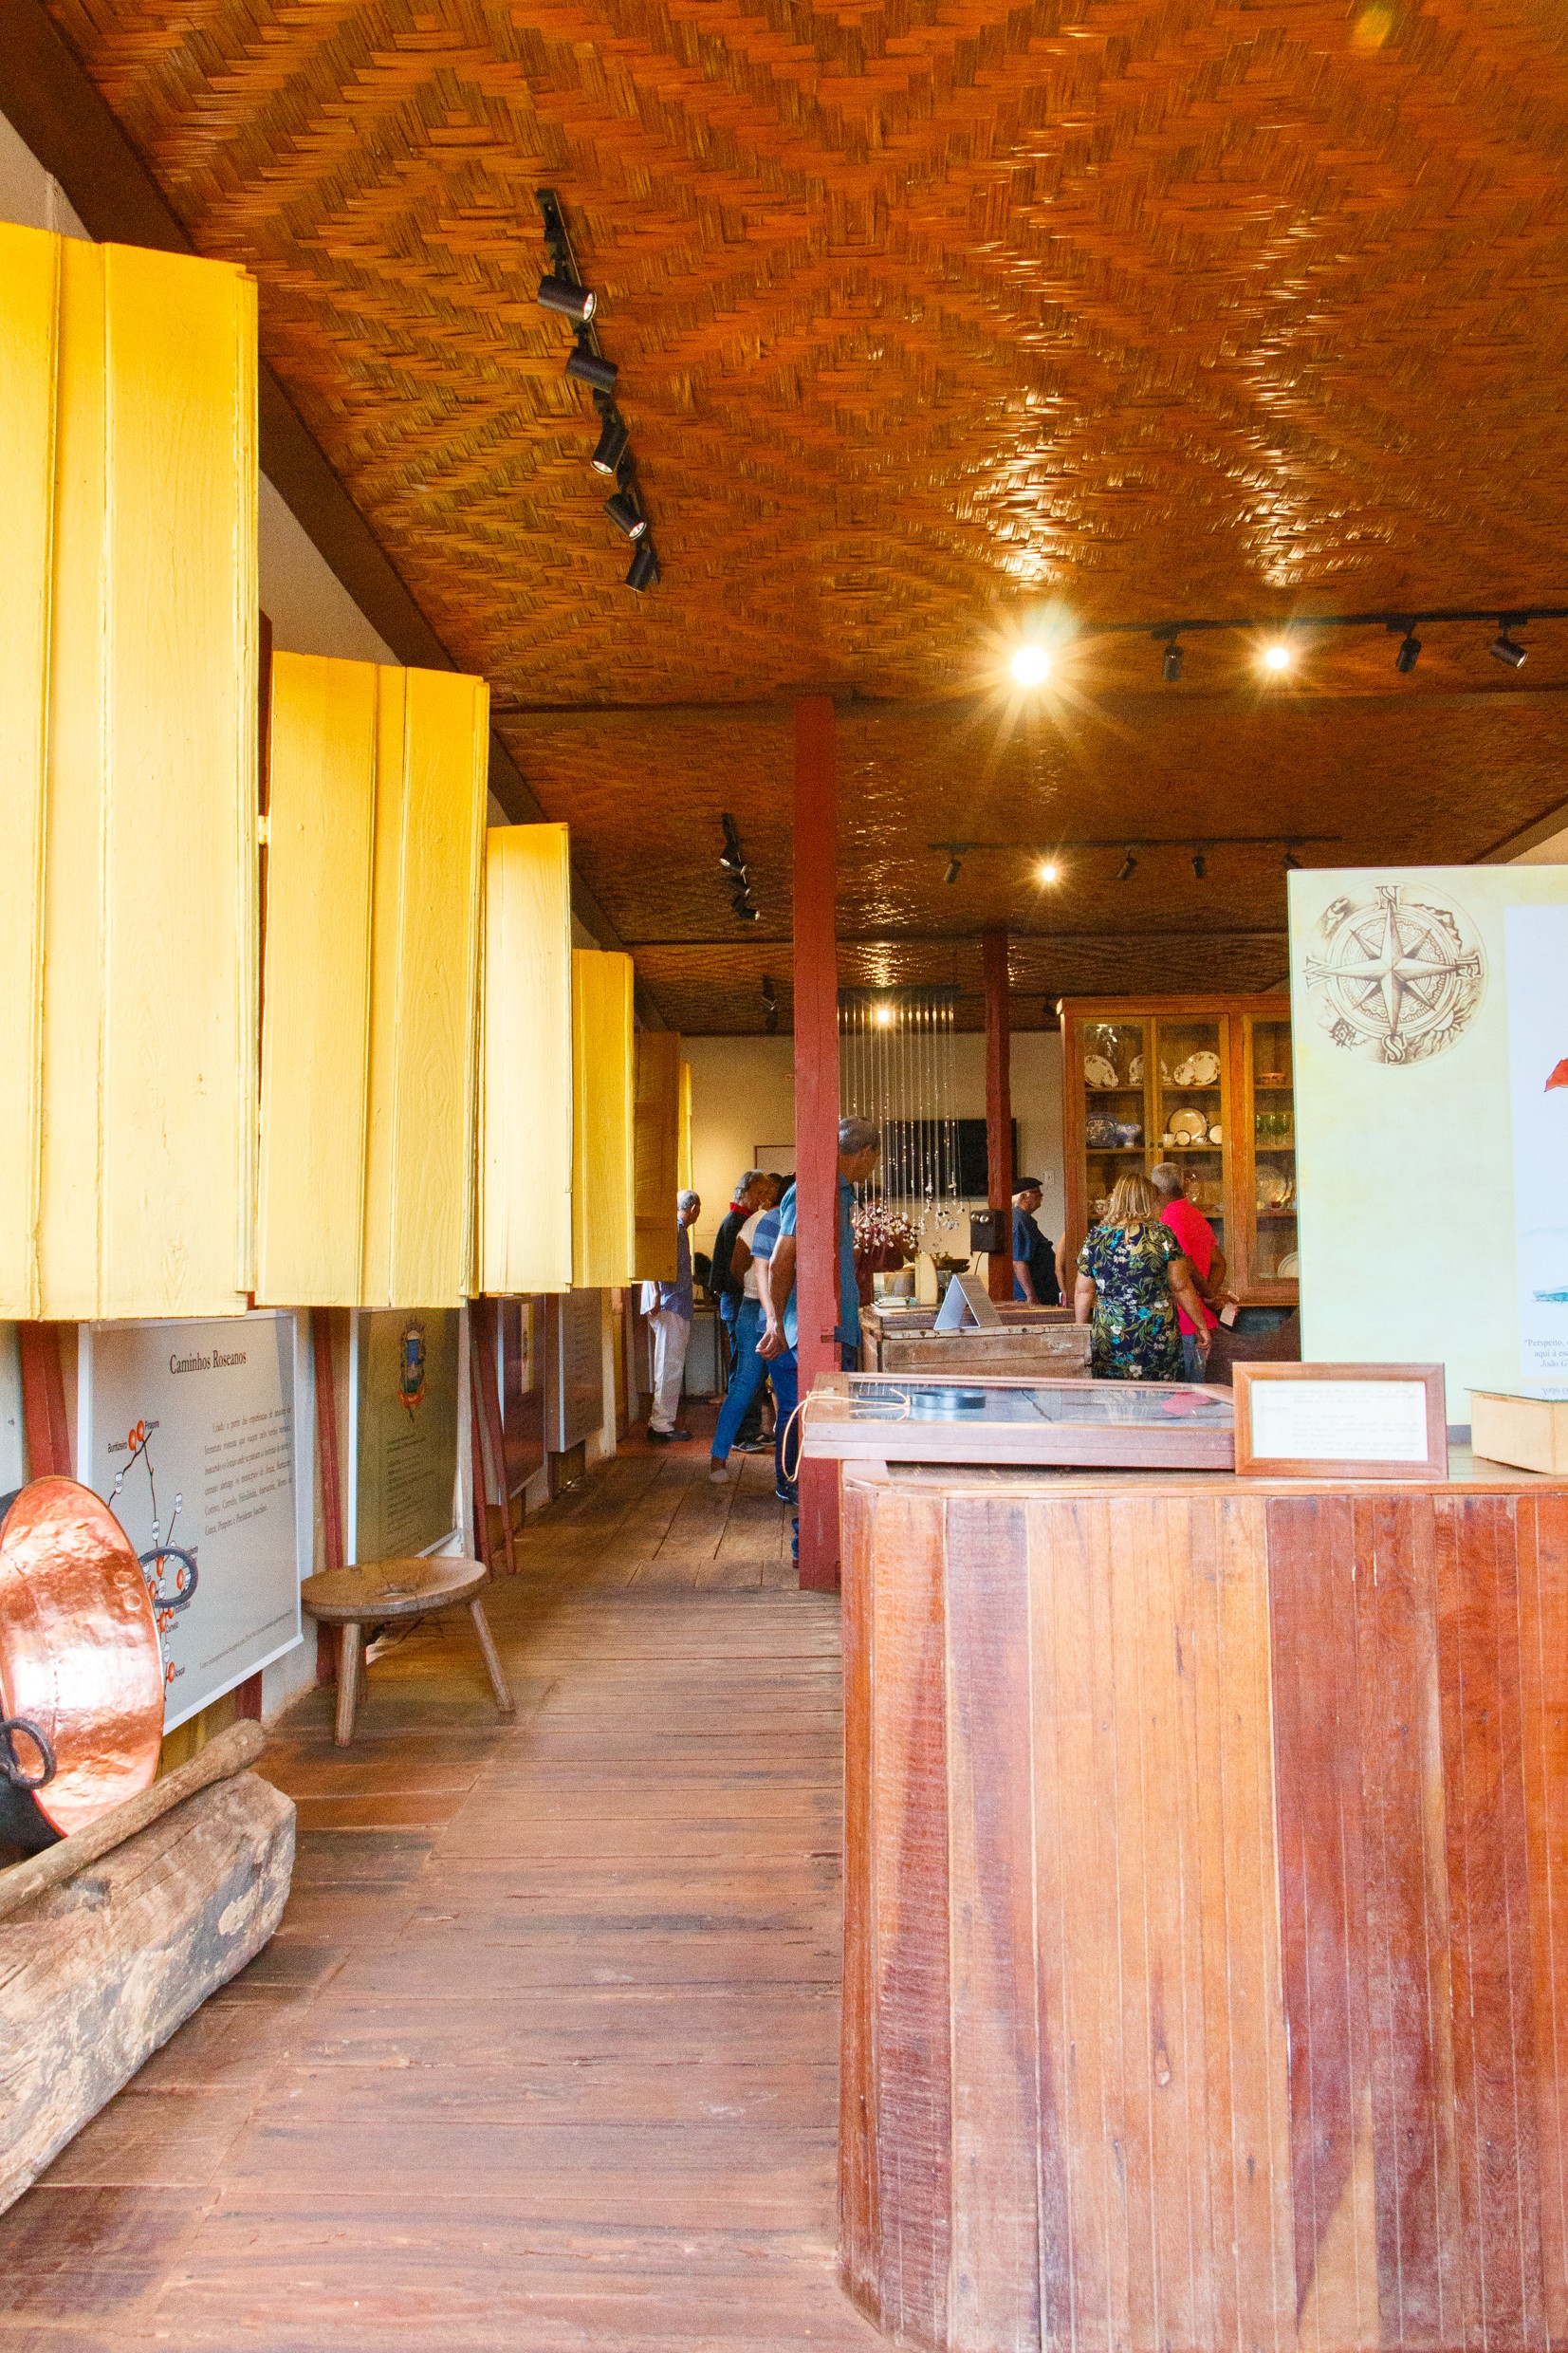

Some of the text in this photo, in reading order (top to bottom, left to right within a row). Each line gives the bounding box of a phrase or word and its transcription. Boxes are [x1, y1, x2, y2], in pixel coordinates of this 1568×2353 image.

[1374, 885, 1400, 911] N
[1302, 955, 1332, 990] W
[1454, 954, 1482, 979] E
[1381, 1031, 1407, 1065] S
[170, 1349, 247, 1375] Caminhos Roseanos
[1534, 1350, 1550, 1360] aqui
